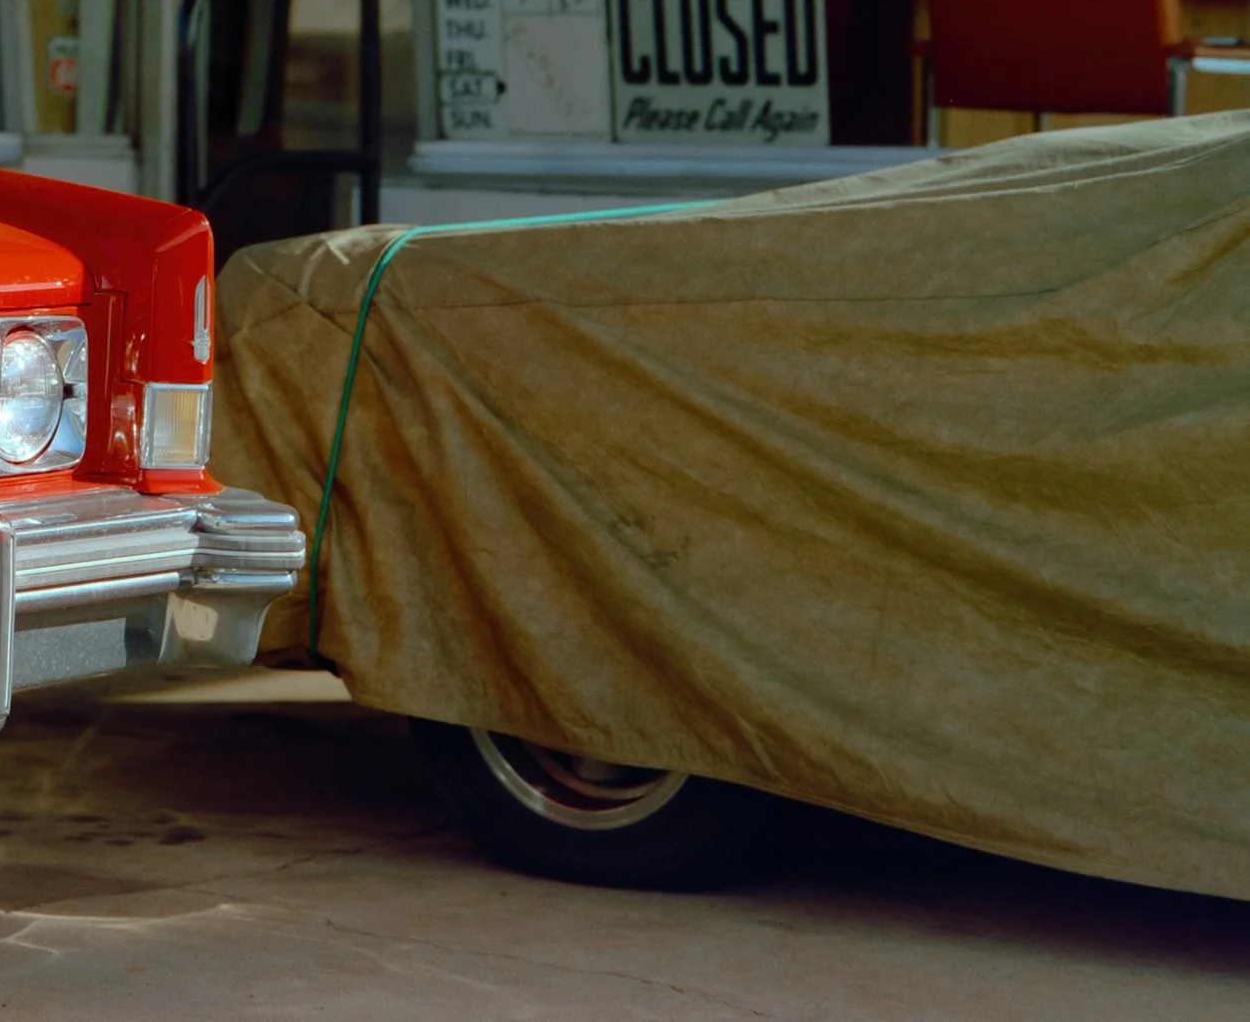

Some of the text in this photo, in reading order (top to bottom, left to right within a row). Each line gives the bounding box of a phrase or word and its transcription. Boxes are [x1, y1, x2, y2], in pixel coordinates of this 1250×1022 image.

[621, 94, 821, 144] Please Call Again
